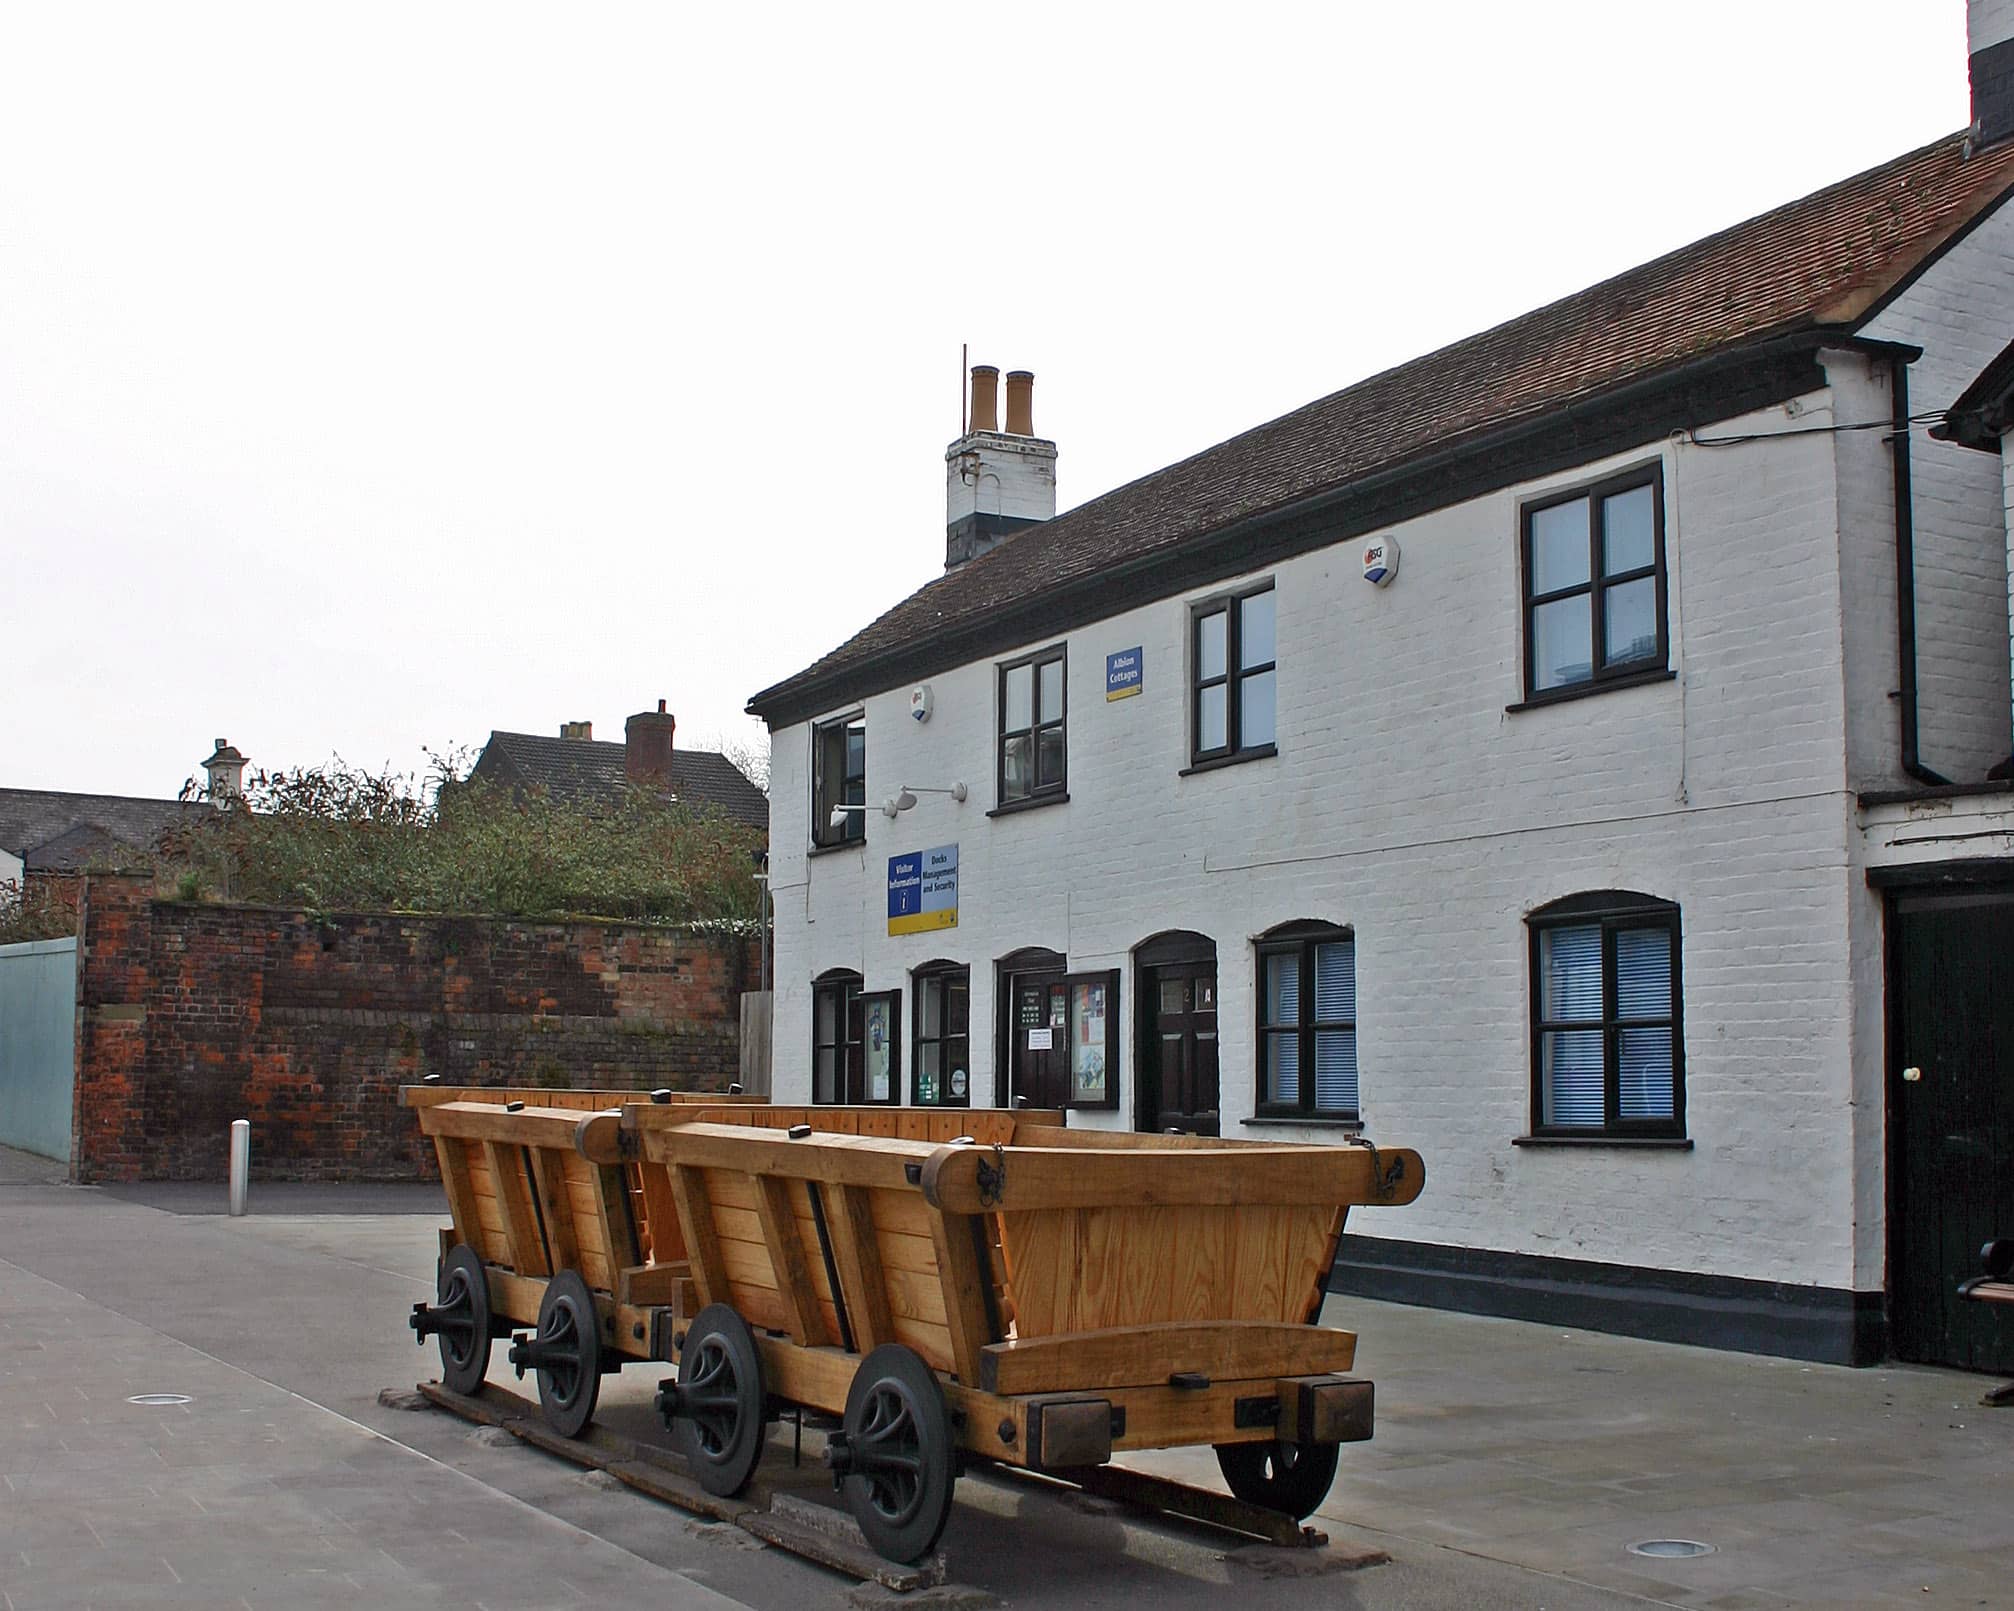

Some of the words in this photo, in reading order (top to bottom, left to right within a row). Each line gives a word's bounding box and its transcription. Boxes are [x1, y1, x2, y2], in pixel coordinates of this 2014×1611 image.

[1113, 656, 1135, 669] Albion
[1110, 670, 1138, 684] Cottages
[931, 854, 947, 865] Docks
[896, 864, 914, 874] Visitor
[922, 866, 957, 880] Management
[889, 876, 920, 889] Information
[923, 882, 933, 893] and
[934, 880, 955, 892] Security
